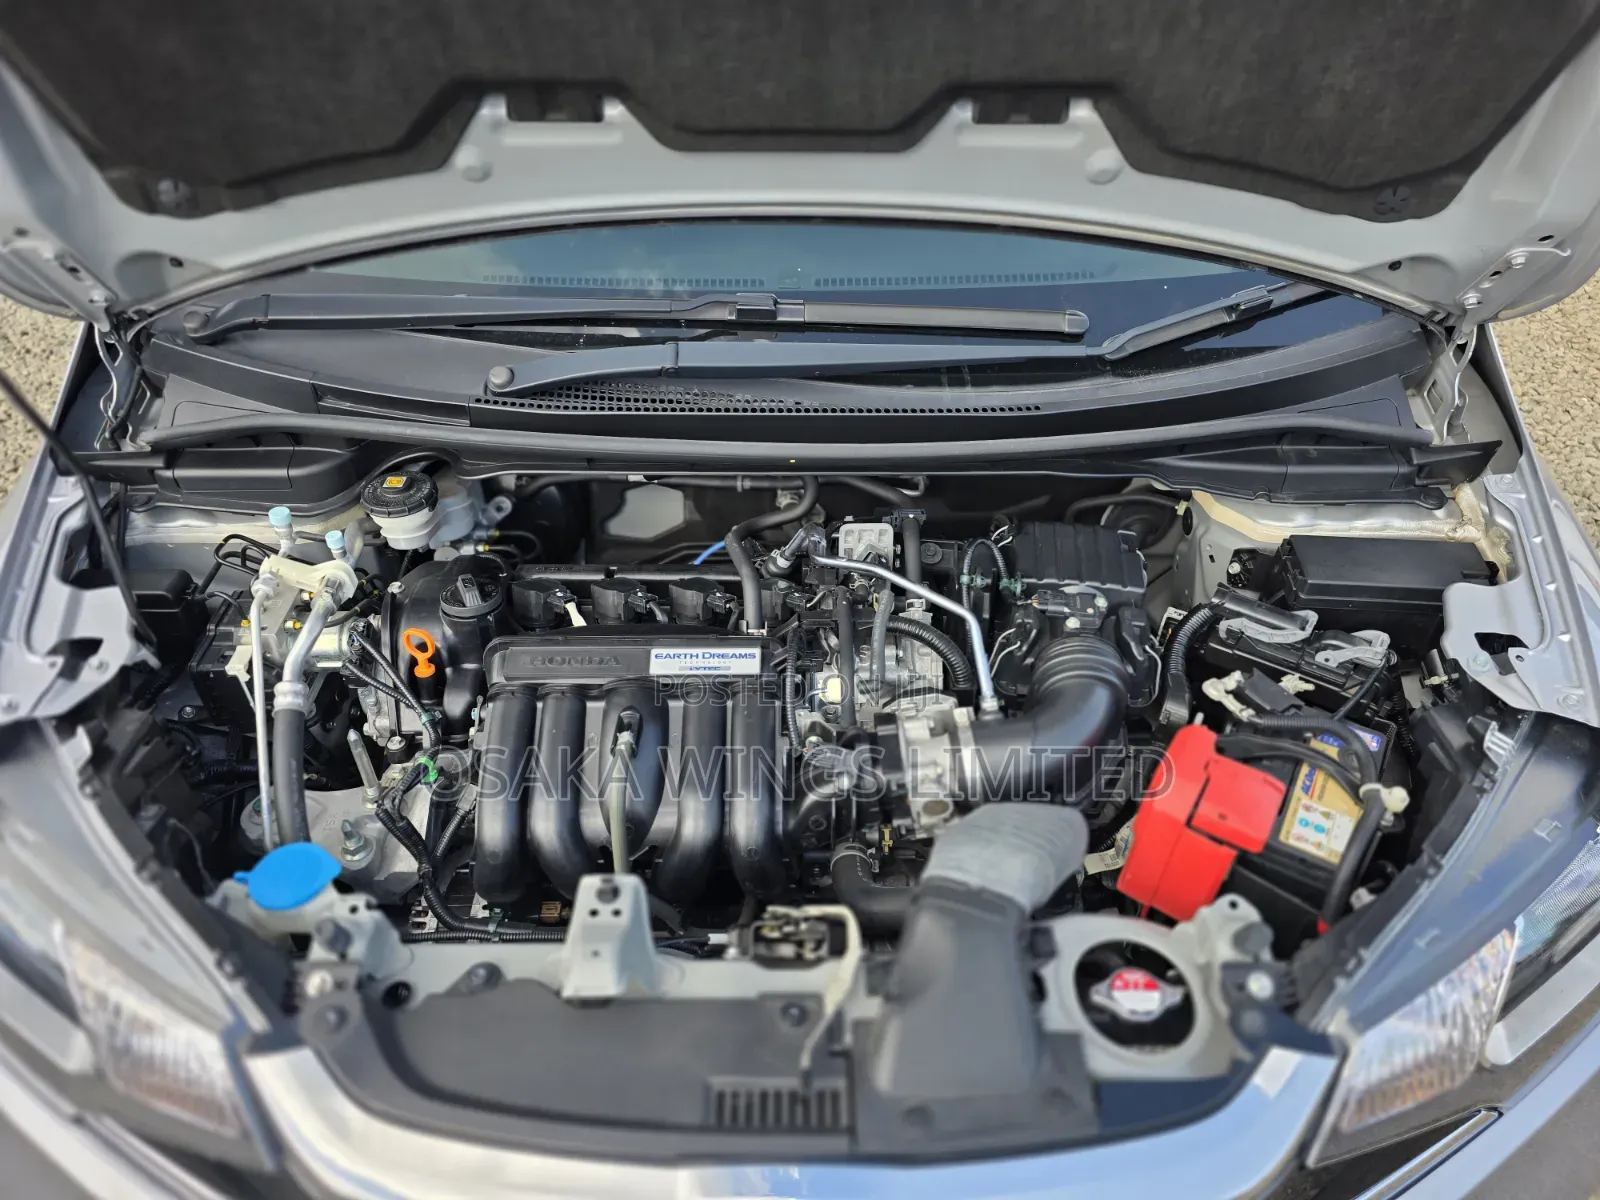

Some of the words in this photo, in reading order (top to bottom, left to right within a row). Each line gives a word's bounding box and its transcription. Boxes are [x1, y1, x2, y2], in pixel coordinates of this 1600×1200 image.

[654, 652, 699, 660] EARTH
[702, 651, 757, 660] DREAMS
[526, 656, 623, 668] HONDA
